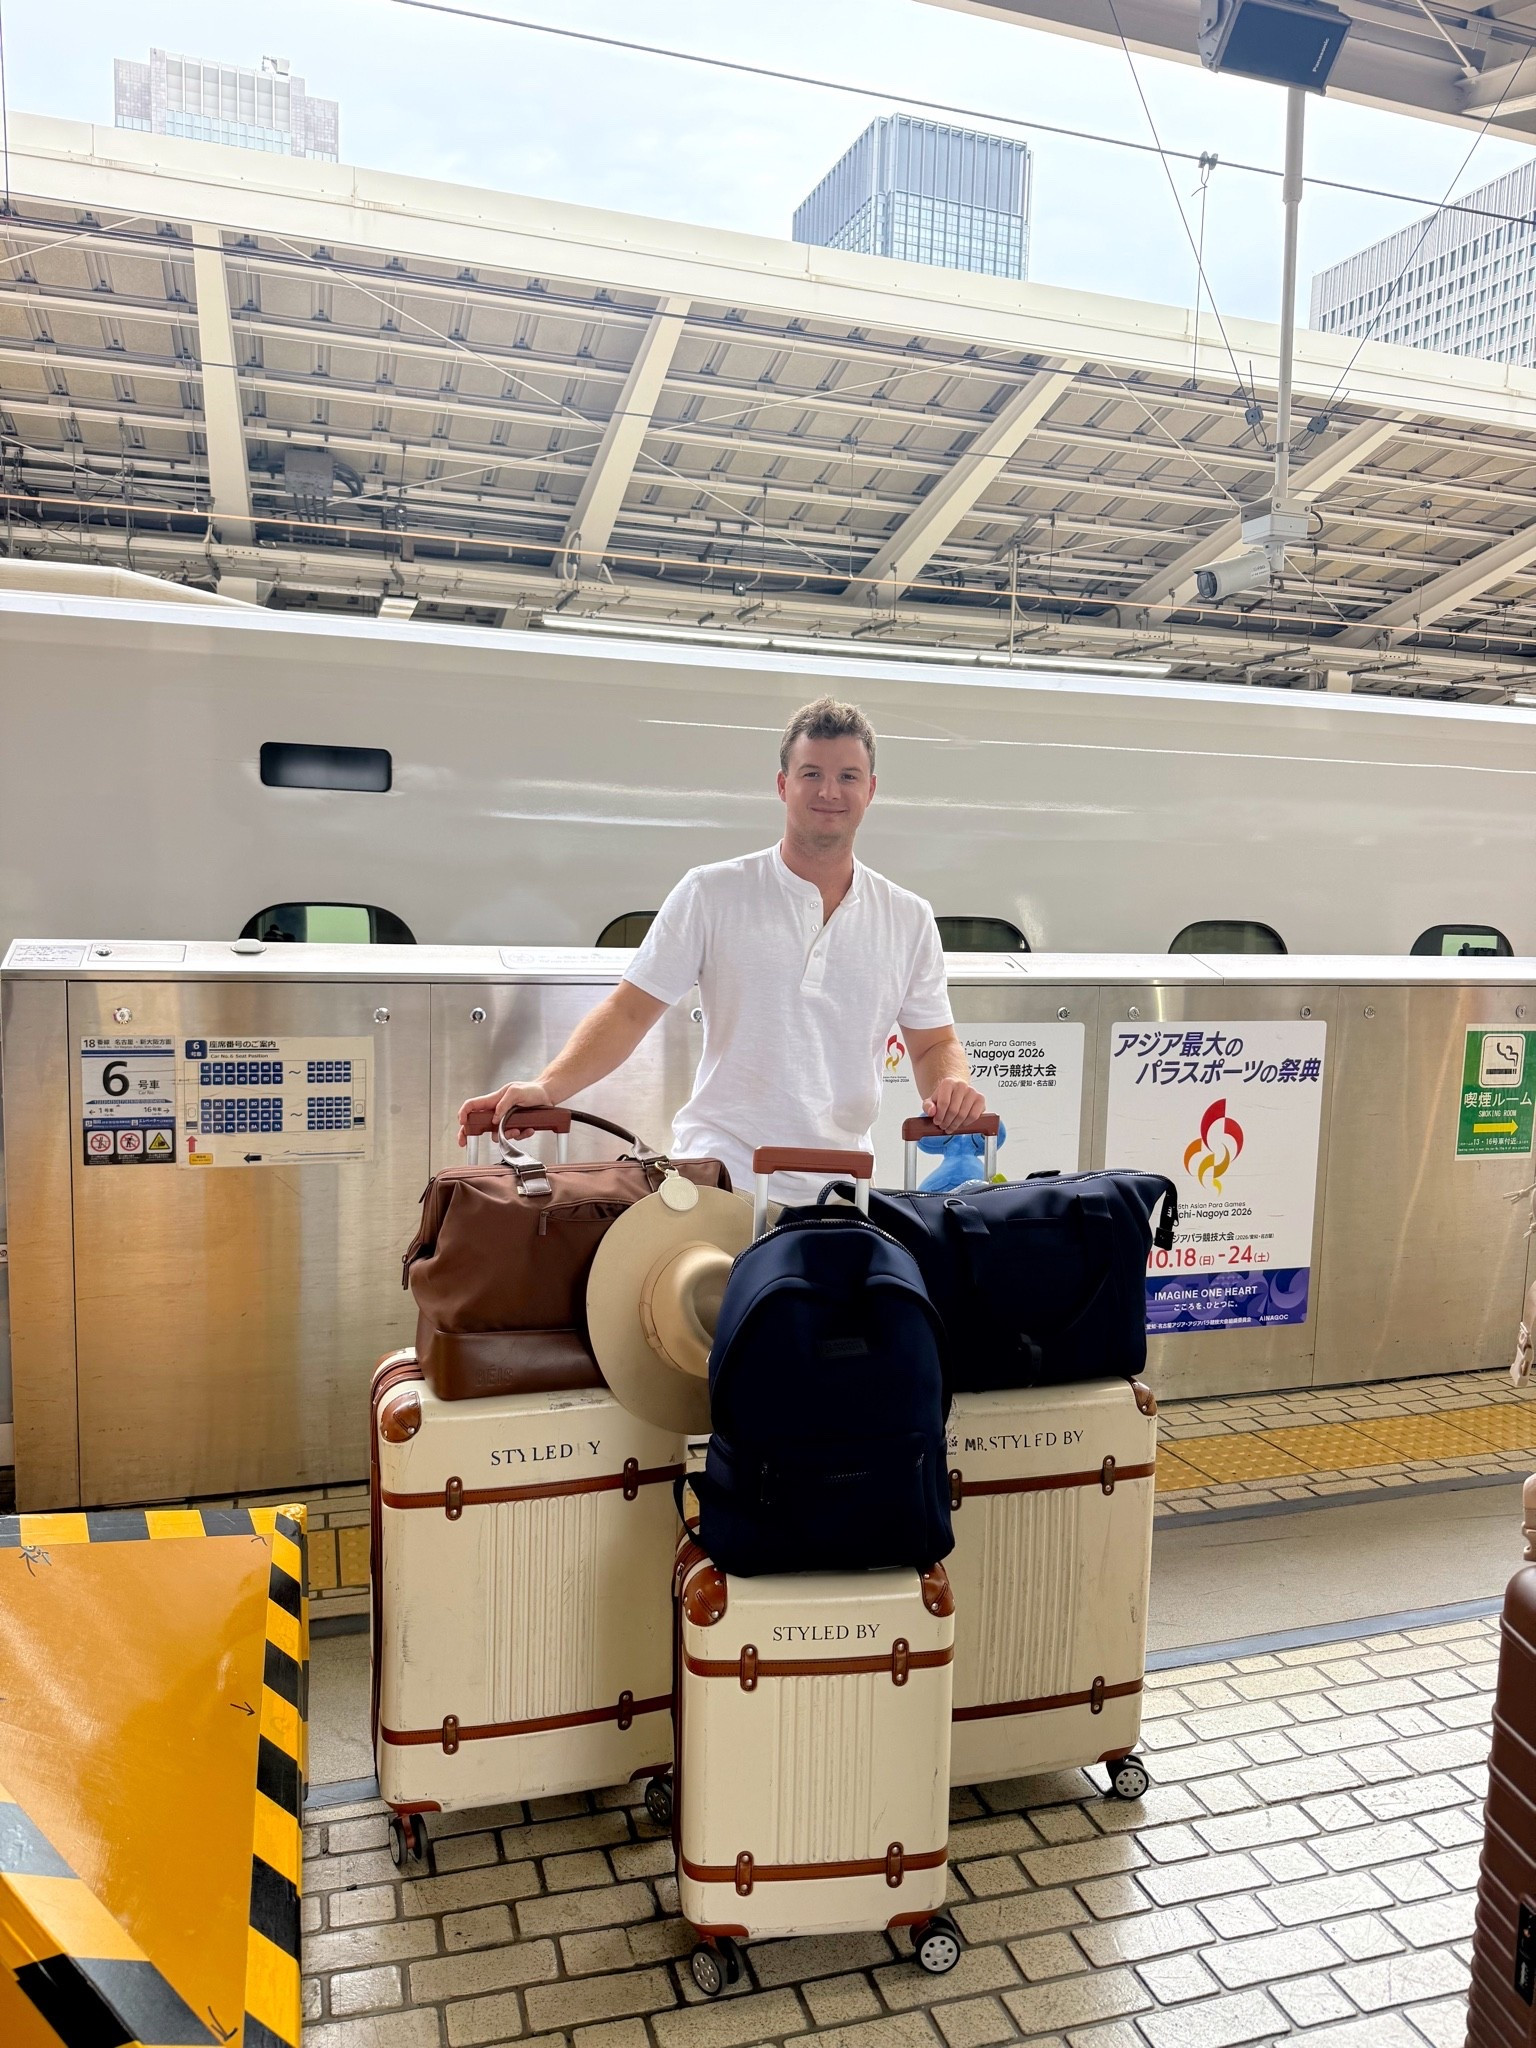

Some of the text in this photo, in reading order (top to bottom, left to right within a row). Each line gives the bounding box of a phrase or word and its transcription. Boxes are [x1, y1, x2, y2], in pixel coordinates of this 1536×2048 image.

[193, 1042, 200, 1050] 6
[209, 1040, 276, 1048] 座席番号のご案内
[1114, 1030, 1244, 1057] アジア最大の
[1018, 1048, 1045, 1058] 2026
[102, 1060, 160, 1097] 6 号車
[1135, 1058, 1322, 1085] パラスポーツの祭典
[1463, 1091, 1533, 1109] 喫煙ルーム
[1503, 1109, 1517, 1117] ROOM
[1178, 1208, 1229, 1220] chi-Nagoya
[1231, 1207, 1253, 1216] 2026
[1172, 1231, 1235, 1244] ジアパラ競技大会
[1154, 1285, 1258, 1301] IMAGINE ONE HEART
[1259, 1313, 1289, 1322] AINAGOC
[1063, 1430, 1084, 1445] BY
[491, 1440, 601, 1466] STYLED Y
[772, 1623, 881, 1641] STYLED BY
